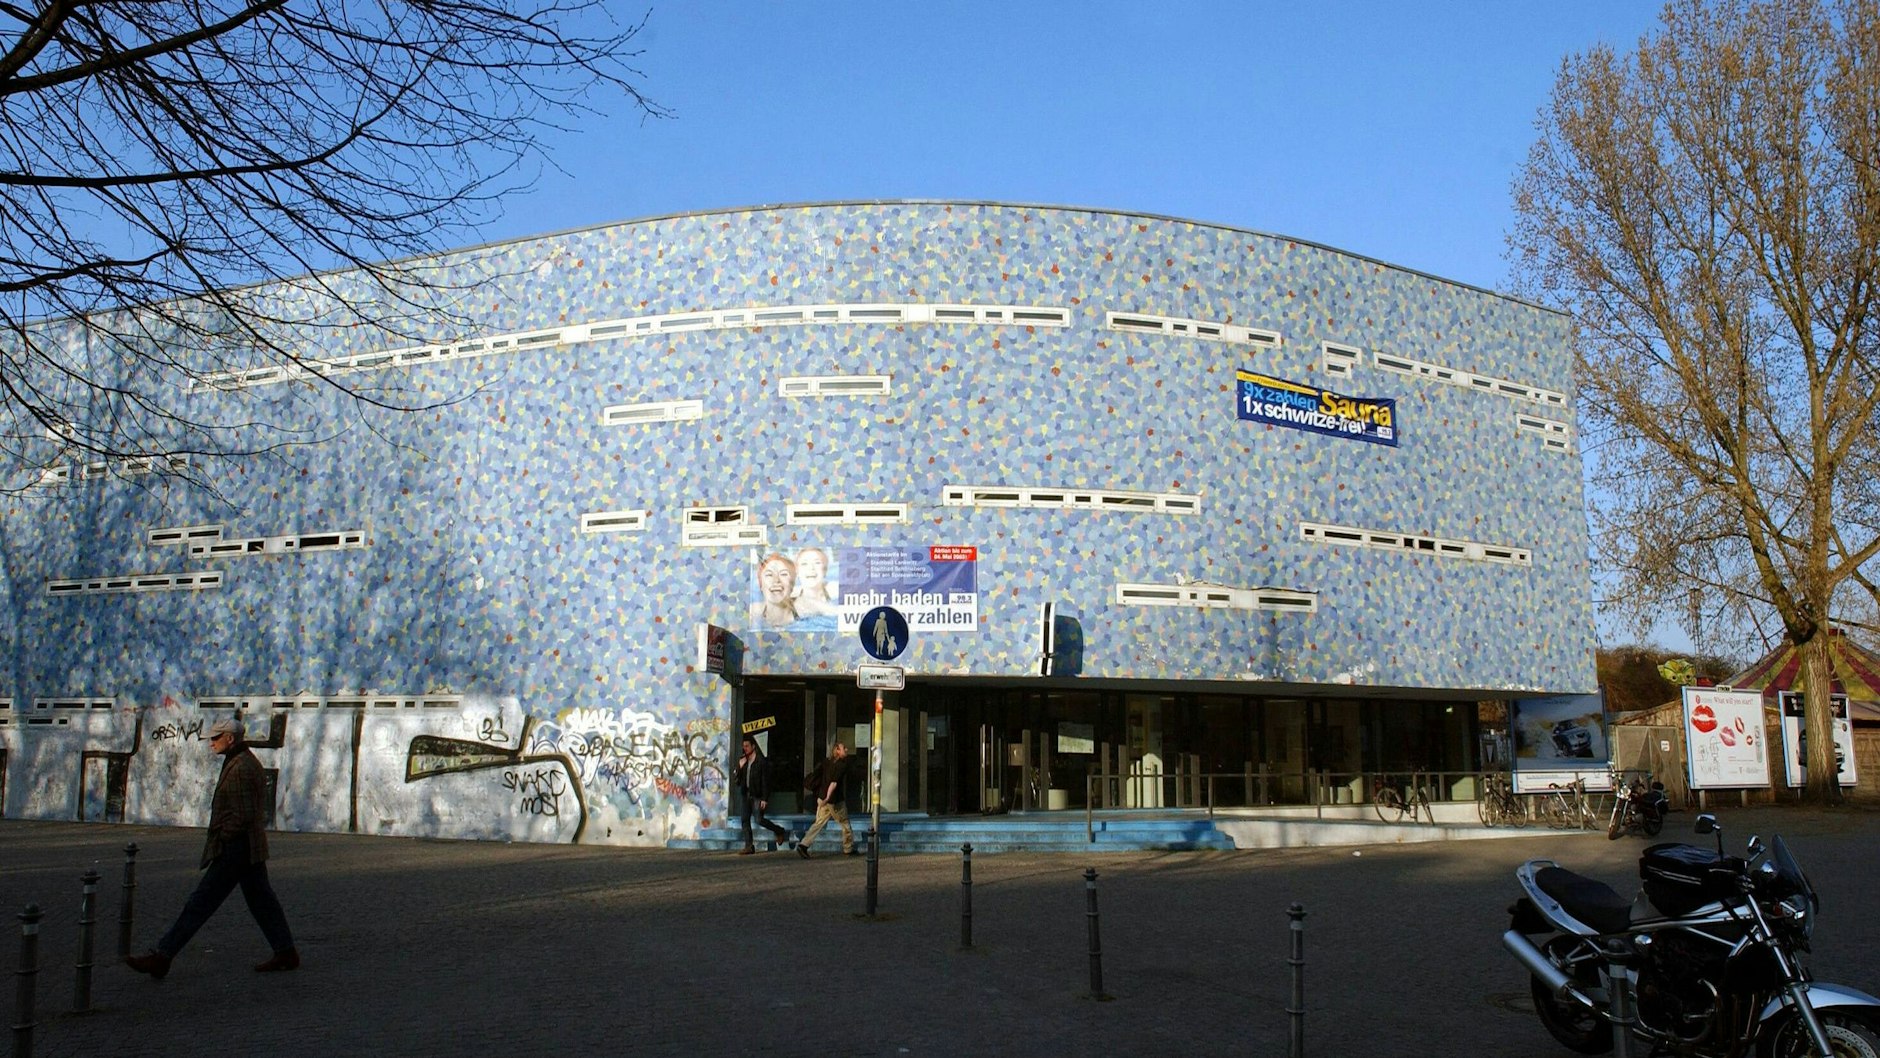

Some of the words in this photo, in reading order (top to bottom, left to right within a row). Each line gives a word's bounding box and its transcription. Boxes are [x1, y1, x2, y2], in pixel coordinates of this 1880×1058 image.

[1243, 381, 1264, 398] 9x
[1266, 388, 1317, 411] zahlen
[1243, 396, 1263, 415] 1x
[1264, 402, 1366, 435] schwitze-frei!
[1319, 391, 1392, 427] Sauna
[844, 588, 887, 605] mehr
[891, 588, 943, 605] baden
[917, 608, 973, 624] zahlen
[744, 718, 773, 731] PIZZA
